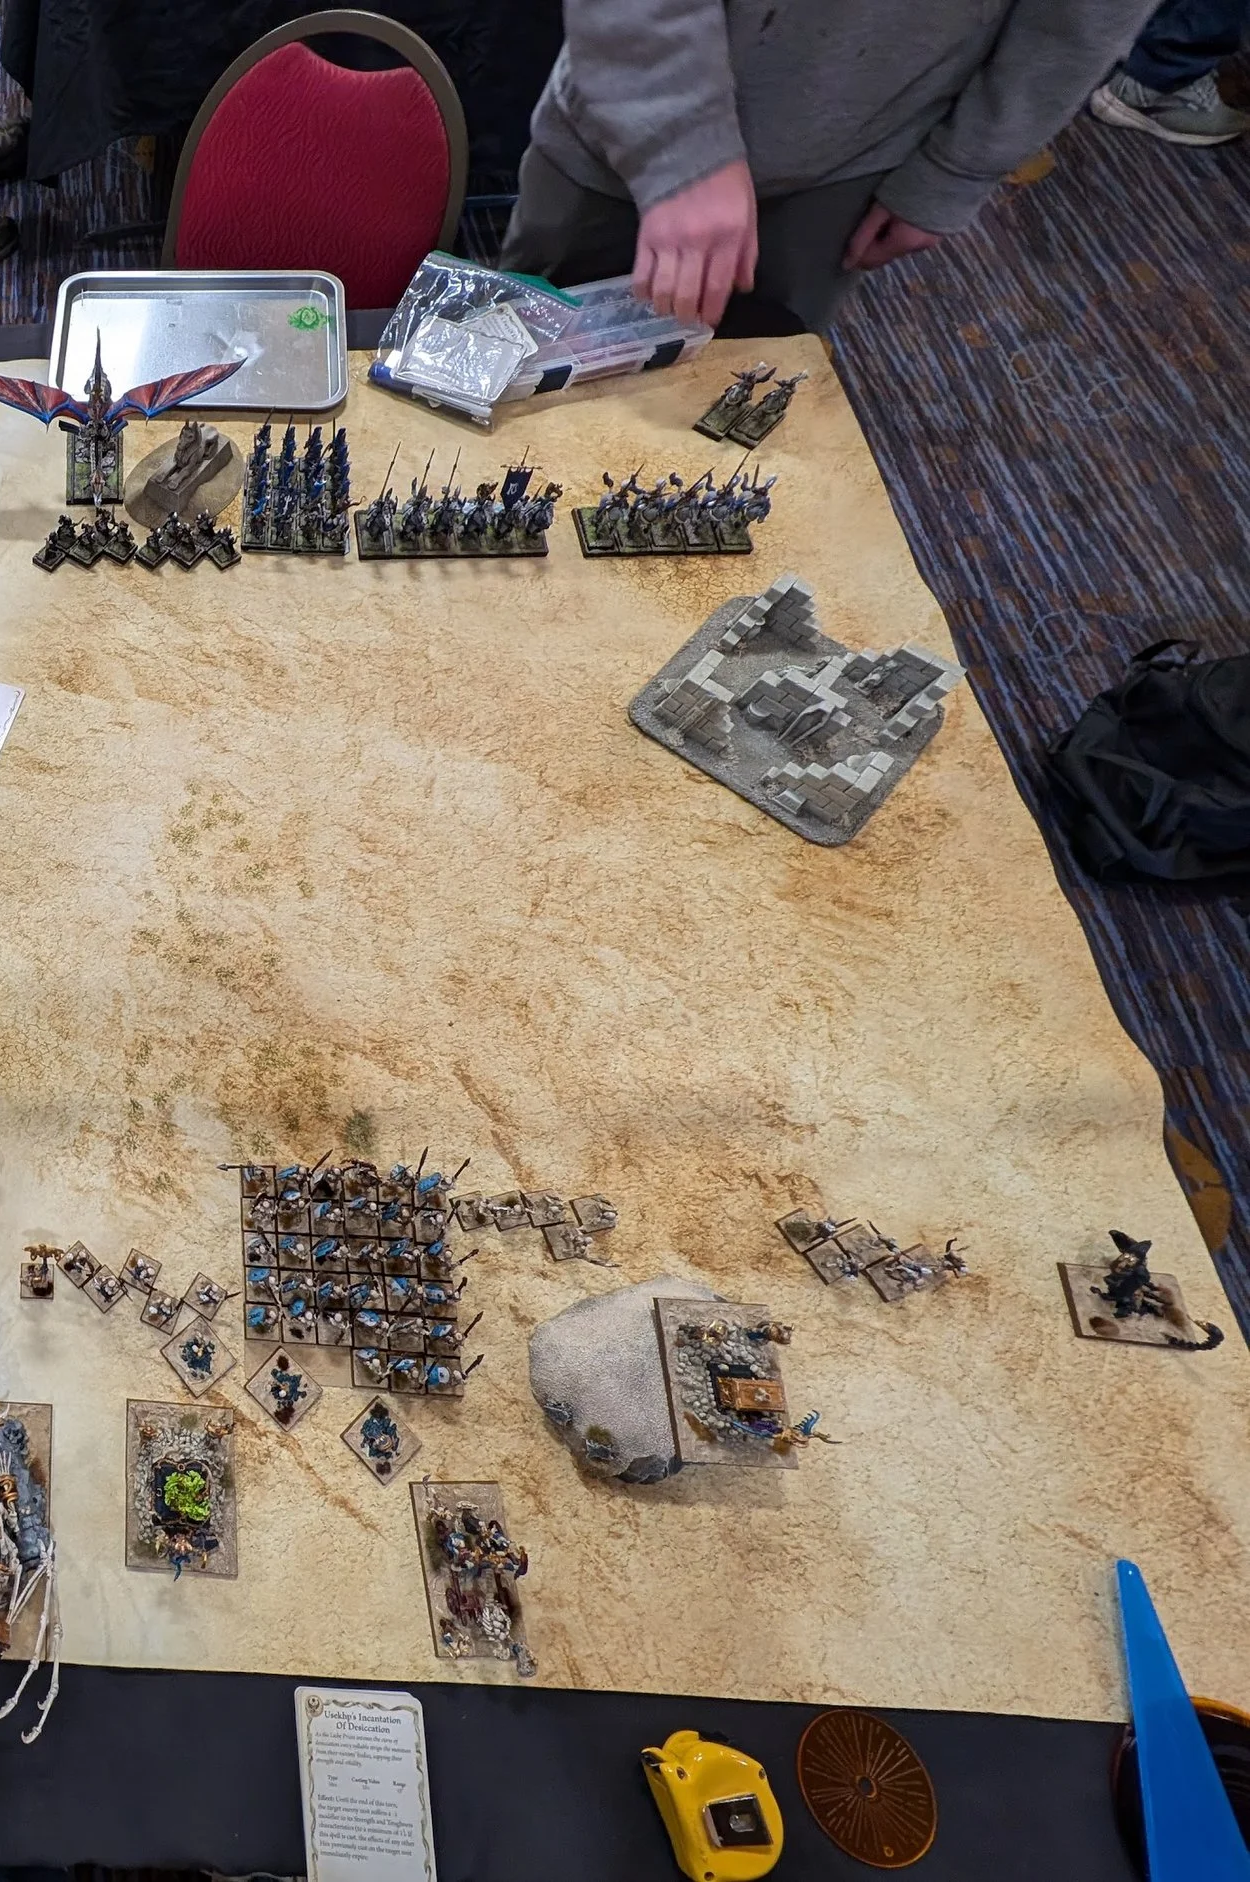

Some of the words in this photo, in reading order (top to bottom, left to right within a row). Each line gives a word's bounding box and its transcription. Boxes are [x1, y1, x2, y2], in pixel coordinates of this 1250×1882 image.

[324, 1710, 356, 1723] Usekhp's
[358, 1713, 401, 1724] Incantation
[336, 1721, 346, 1729] Of
[348, 1722, 390, 1733] Desiccation
[350, 1776, 367, 1784] Casting
[392, 1780, 406, 1788] Range
[353, 1816, 375, 1824] Strength
